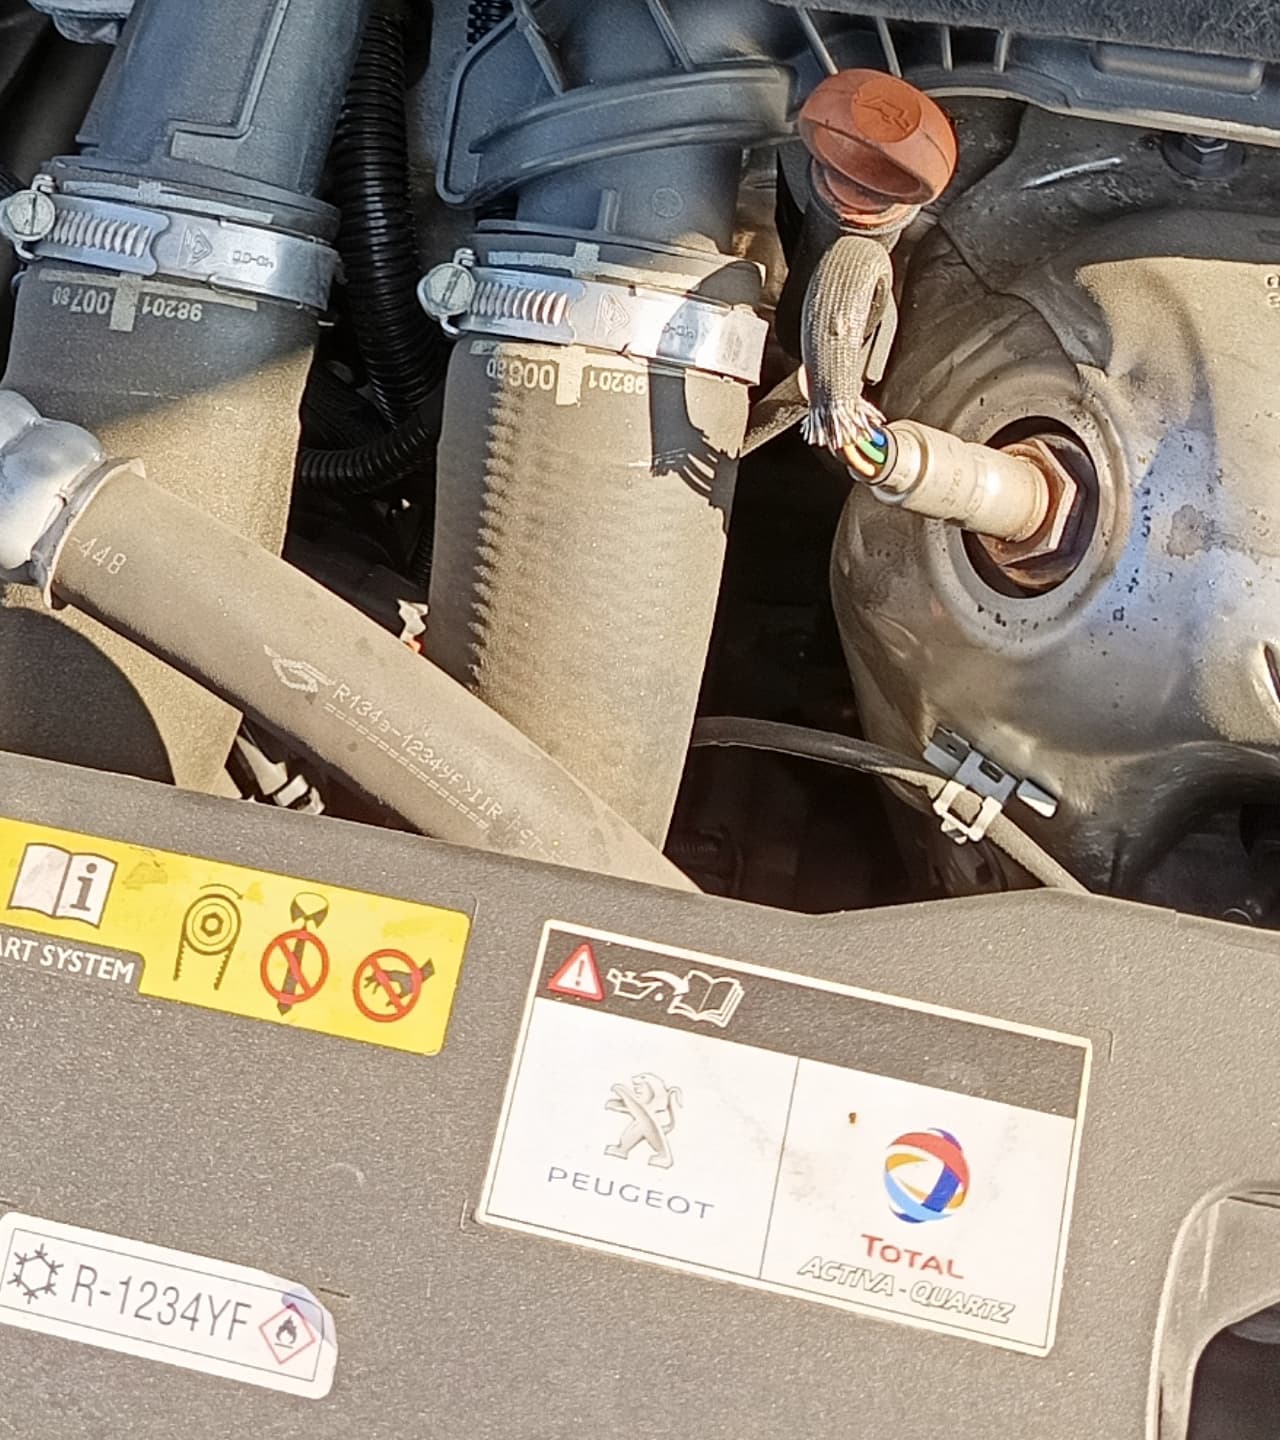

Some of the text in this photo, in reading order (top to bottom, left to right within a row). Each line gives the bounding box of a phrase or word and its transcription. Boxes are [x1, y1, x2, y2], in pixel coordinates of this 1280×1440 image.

[70, 286, 110, 315] 007
[140, 294, 203, 322] 98201
[586, 369, 647, 395] 98201
[39, 943, 136, 985] SYSTEM
[547, 1165, 714, 1220] PEUGEOT
[70, 1262, 254, 1343] R-1234YF
[797, 1255, 896, 1297] ACTIVA
[909, 1280, 1016, 1323] QUARTZ
